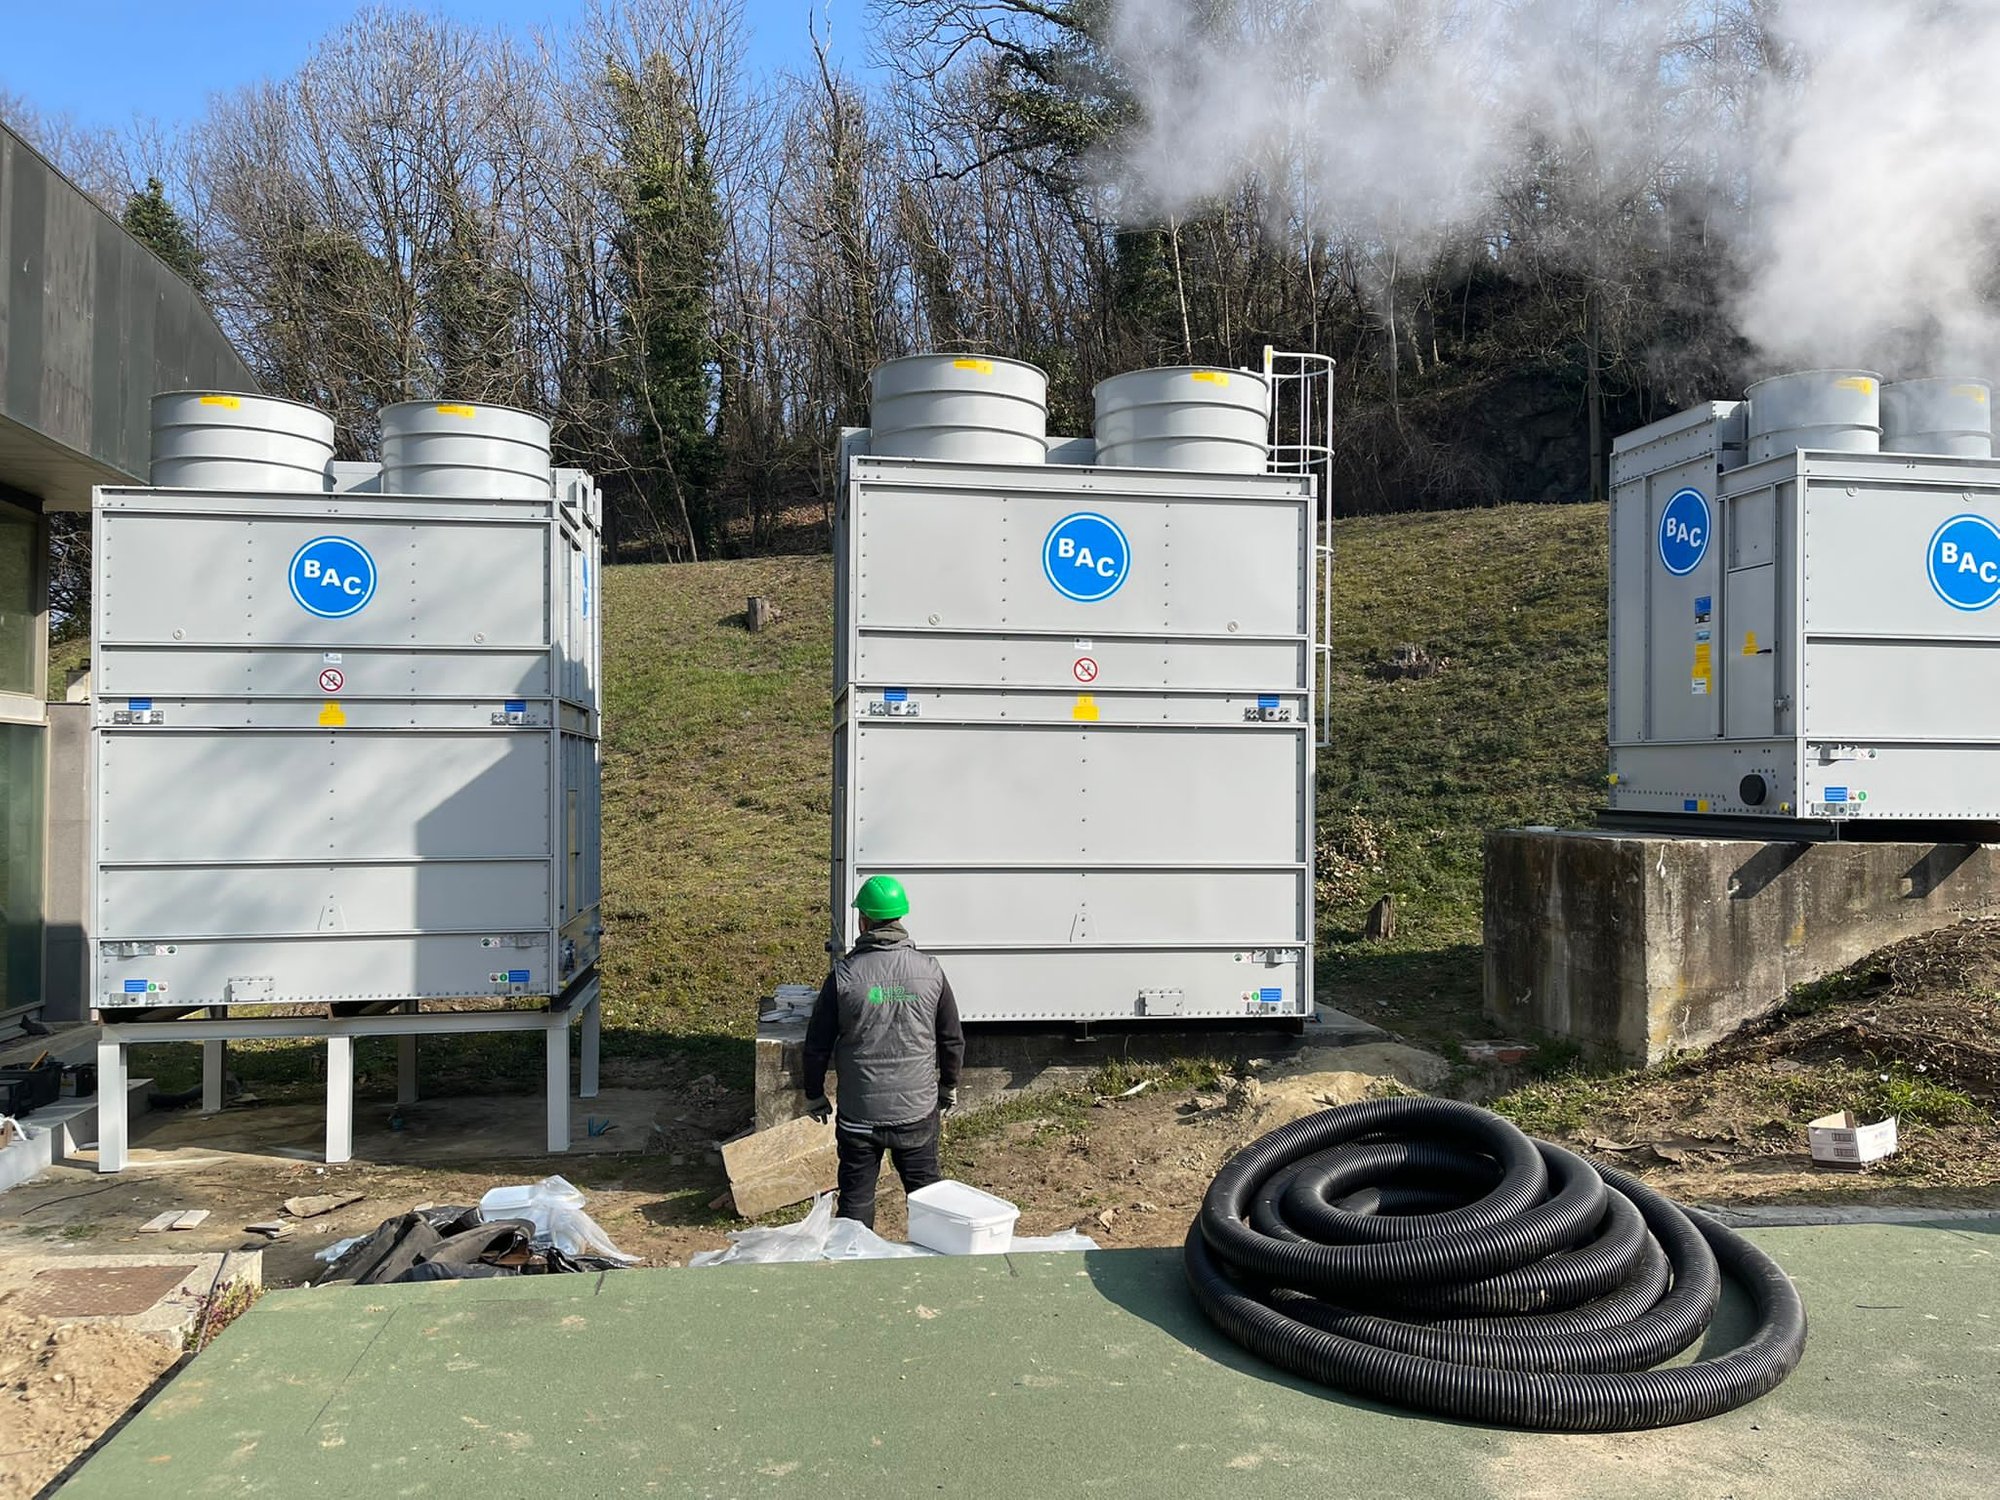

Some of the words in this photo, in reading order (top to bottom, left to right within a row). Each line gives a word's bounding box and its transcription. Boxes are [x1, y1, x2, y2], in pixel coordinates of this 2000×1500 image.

[1666, 517, 1702, 548] BAC
[1058, 537, 1115, 578] BAC
[1941, 541, 1998, 584] BAC
[303, 559, 362, 595] BAC
